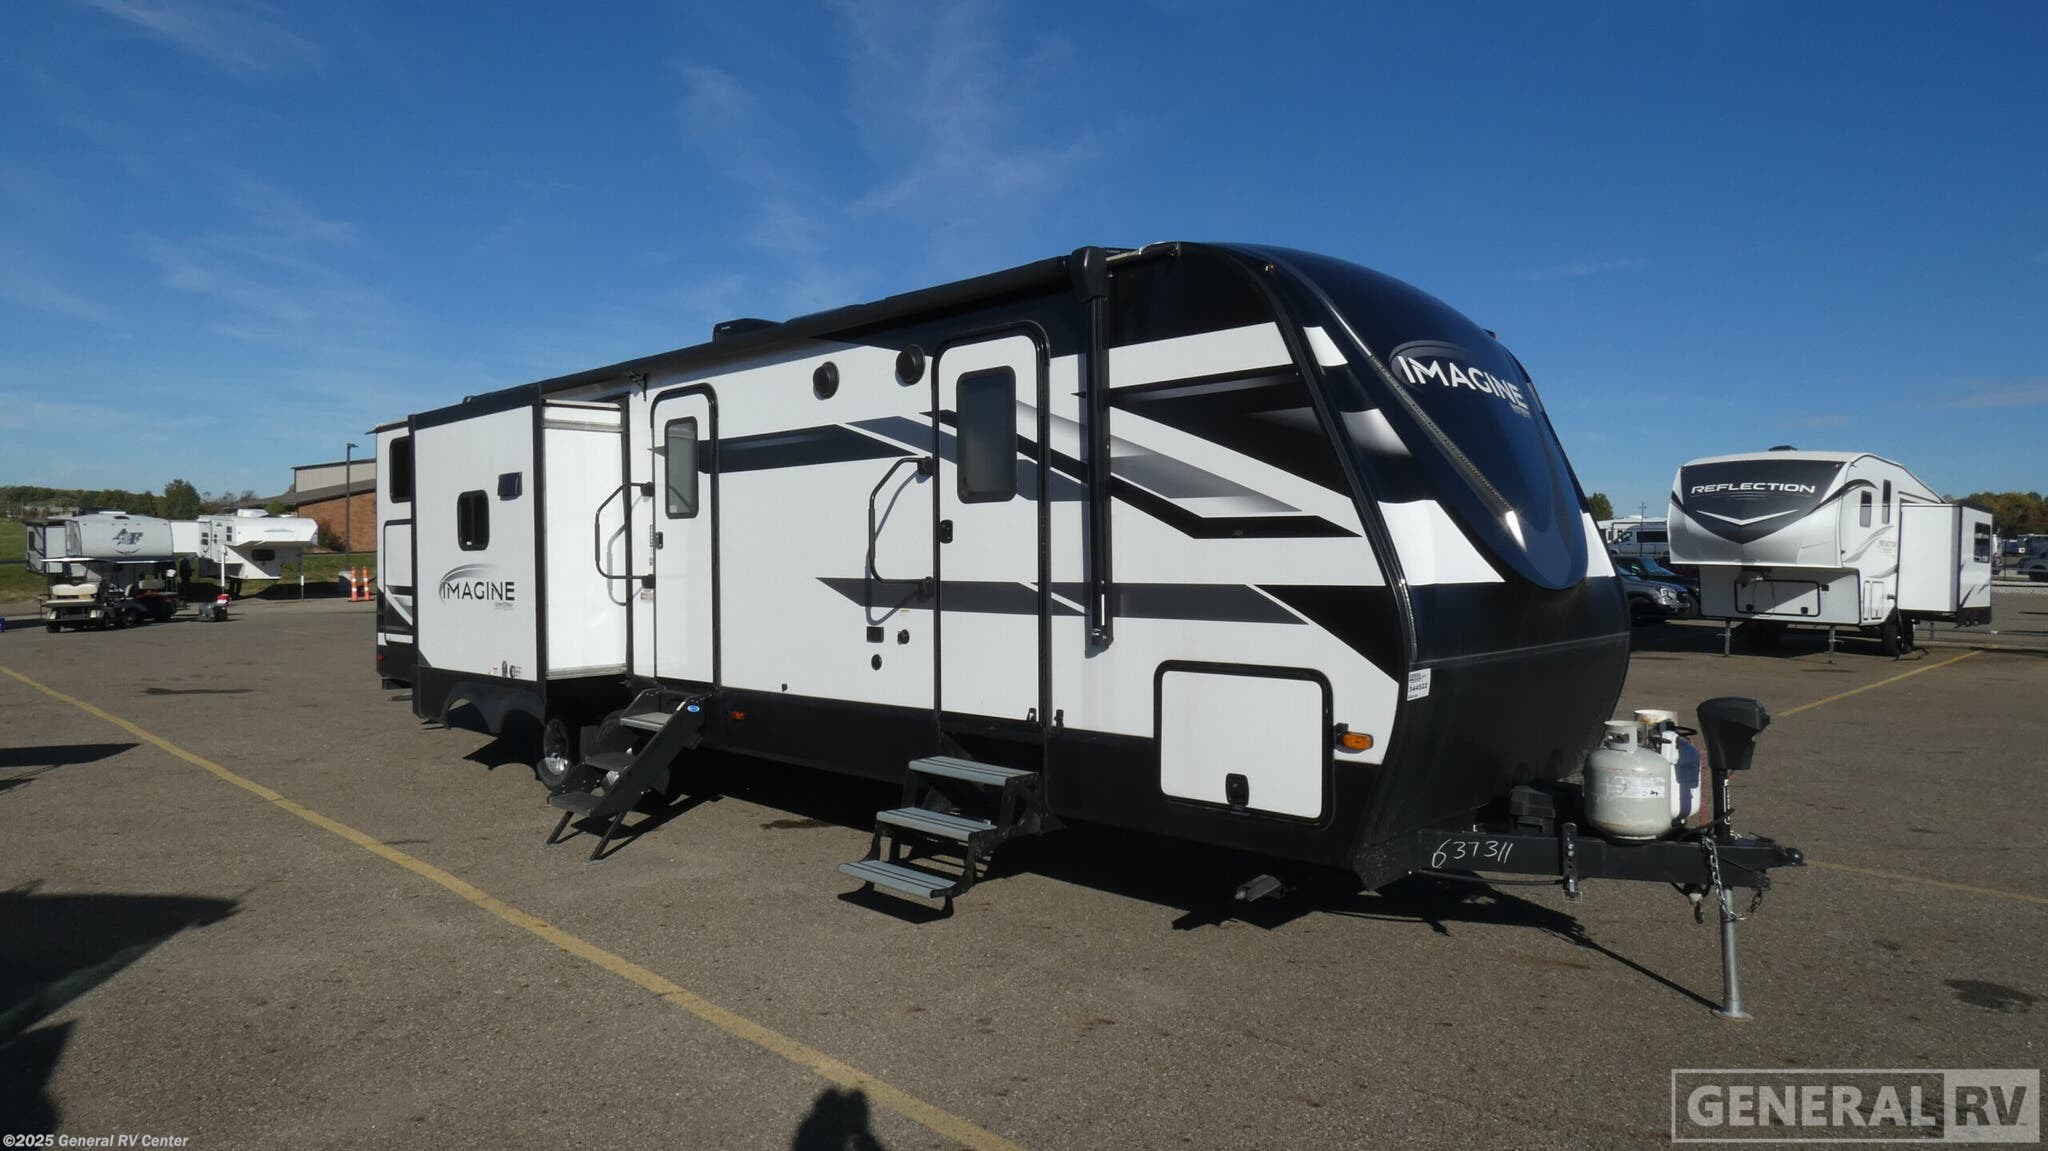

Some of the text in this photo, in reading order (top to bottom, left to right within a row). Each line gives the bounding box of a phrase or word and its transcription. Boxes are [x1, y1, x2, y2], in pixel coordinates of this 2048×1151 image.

[1397, 355, 1529, 410] IMAGINE
[1691, 482, 1816, 494] REFLECTION
[442, 581, 515, 601] IMAGINE
[1432, 838, 1514, 869] 637311
